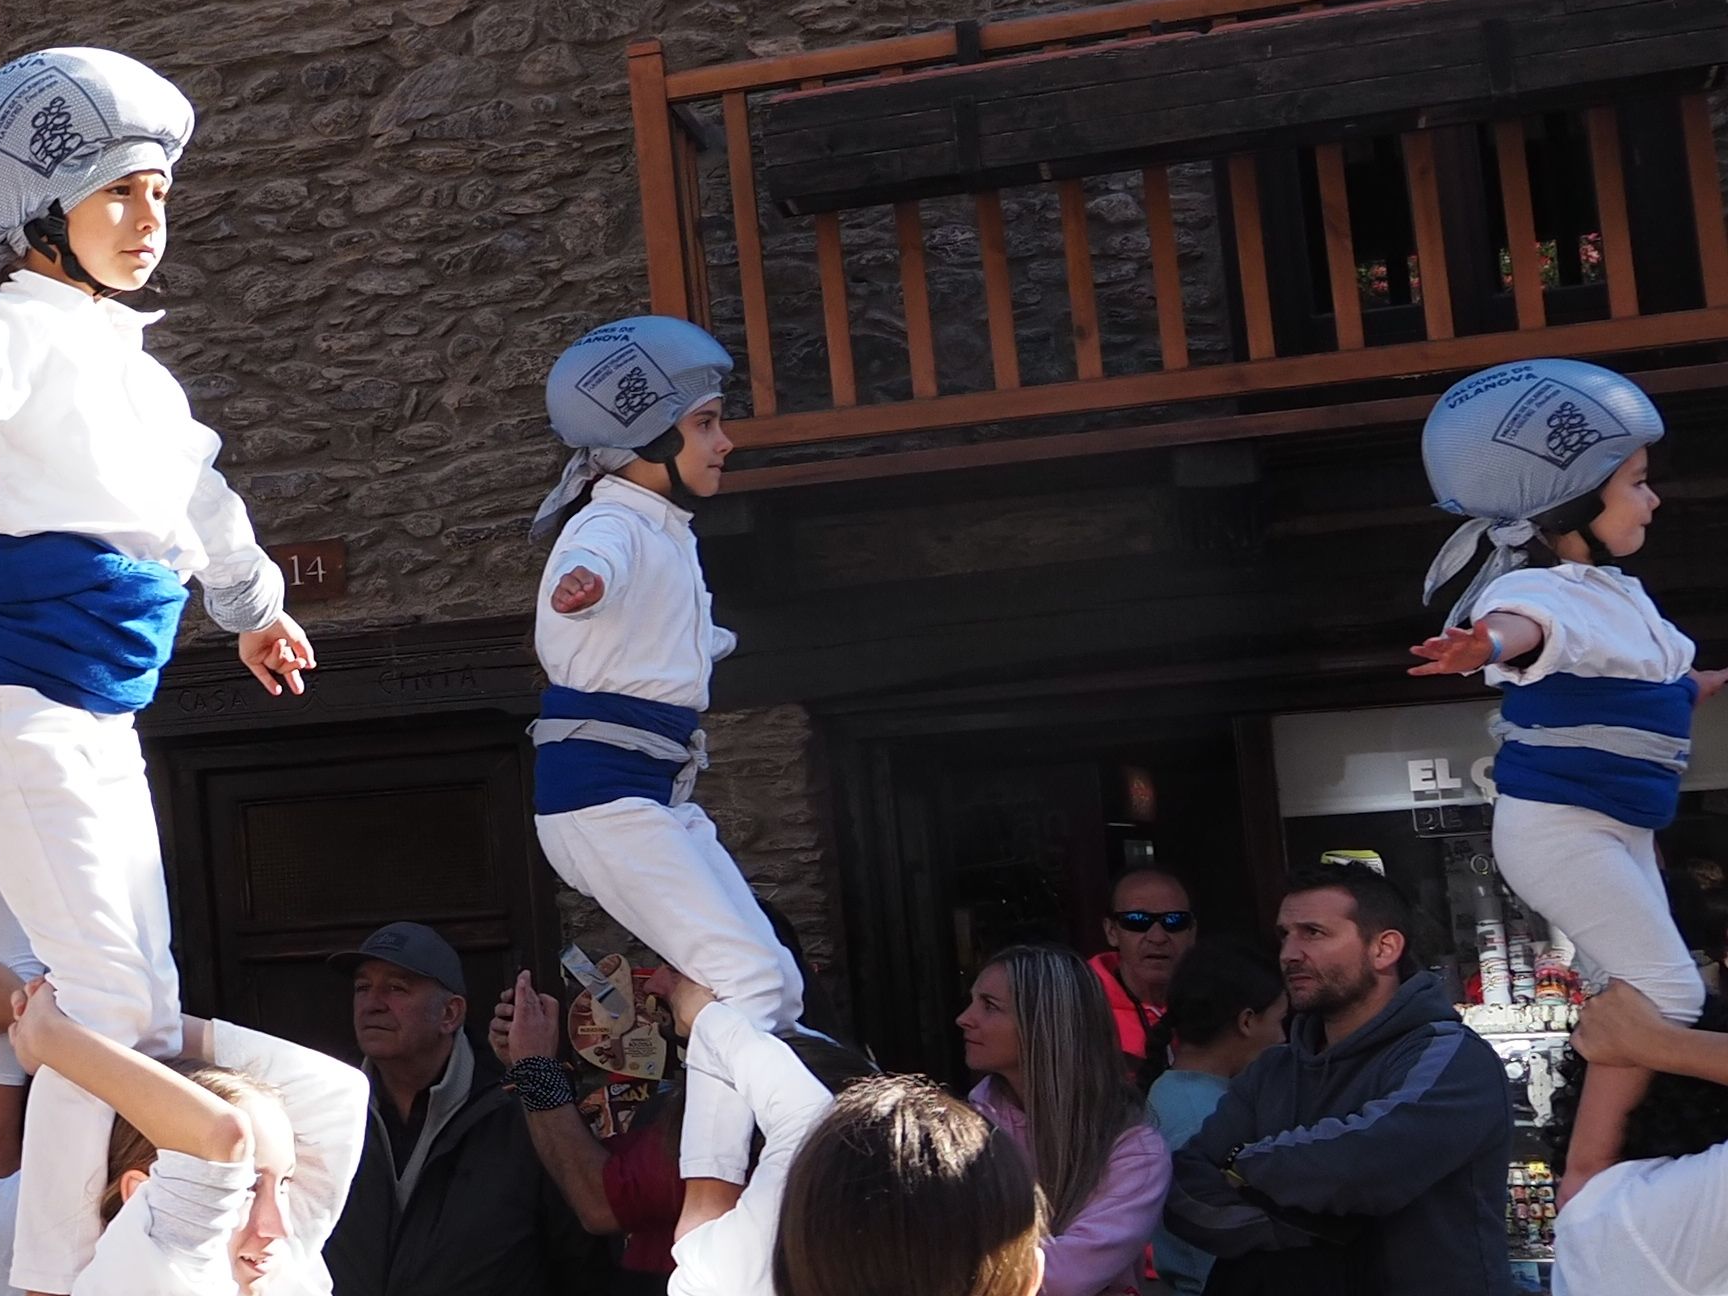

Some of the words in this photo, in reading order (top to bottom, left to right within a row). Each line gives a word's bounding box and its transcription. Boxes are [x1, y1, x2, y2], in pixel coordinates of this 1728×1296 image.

[1448, 373, 1539, 409] VILANOVA
[288, 554, 326, 586] 14
[177, 688, 248, 714] CASA
[378, 664, 477, 694] CINTA
[1408, 758, 1462, 792] EL
